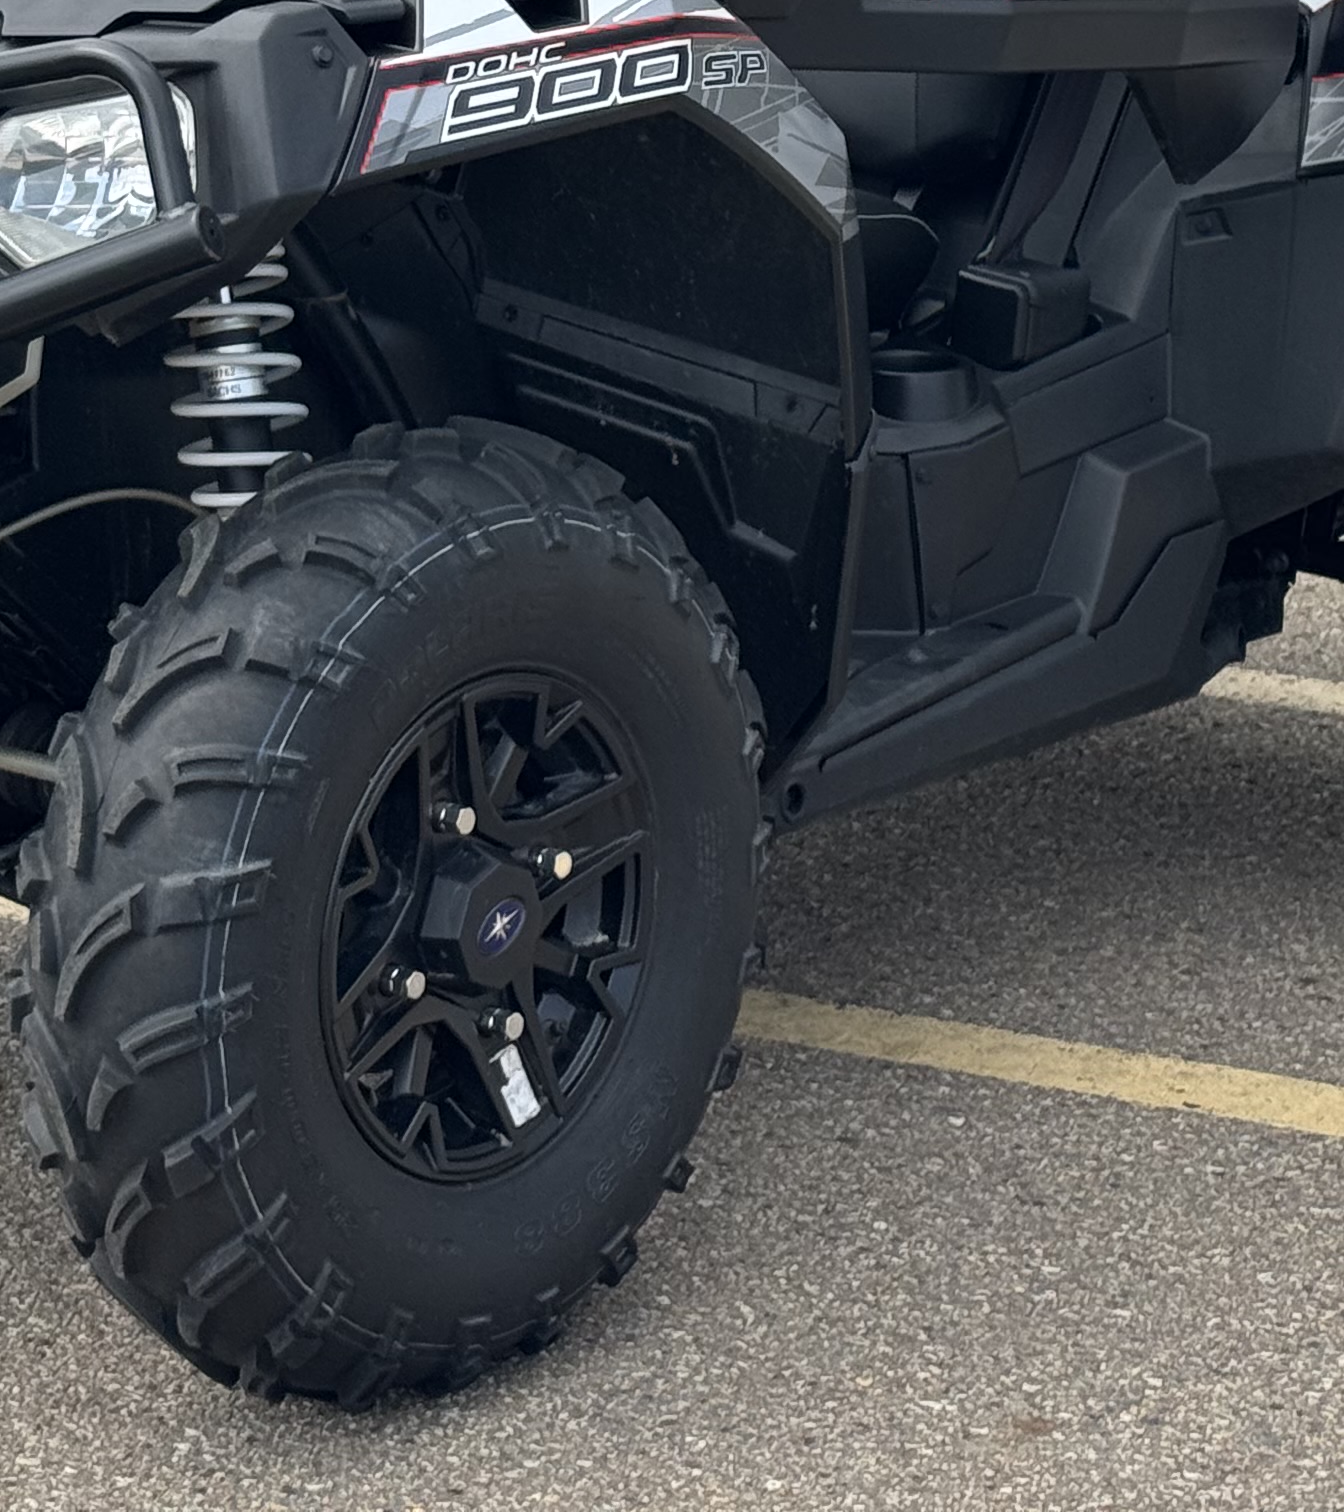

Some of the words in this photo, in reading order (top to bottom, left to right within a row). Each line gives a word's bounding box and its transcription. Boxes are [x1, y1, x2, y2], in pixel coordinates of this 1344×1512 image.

[440, 38, 693, 144] 900
[702, 50, 767, 90] SP
[445, 41, 566, 85] DOHC
